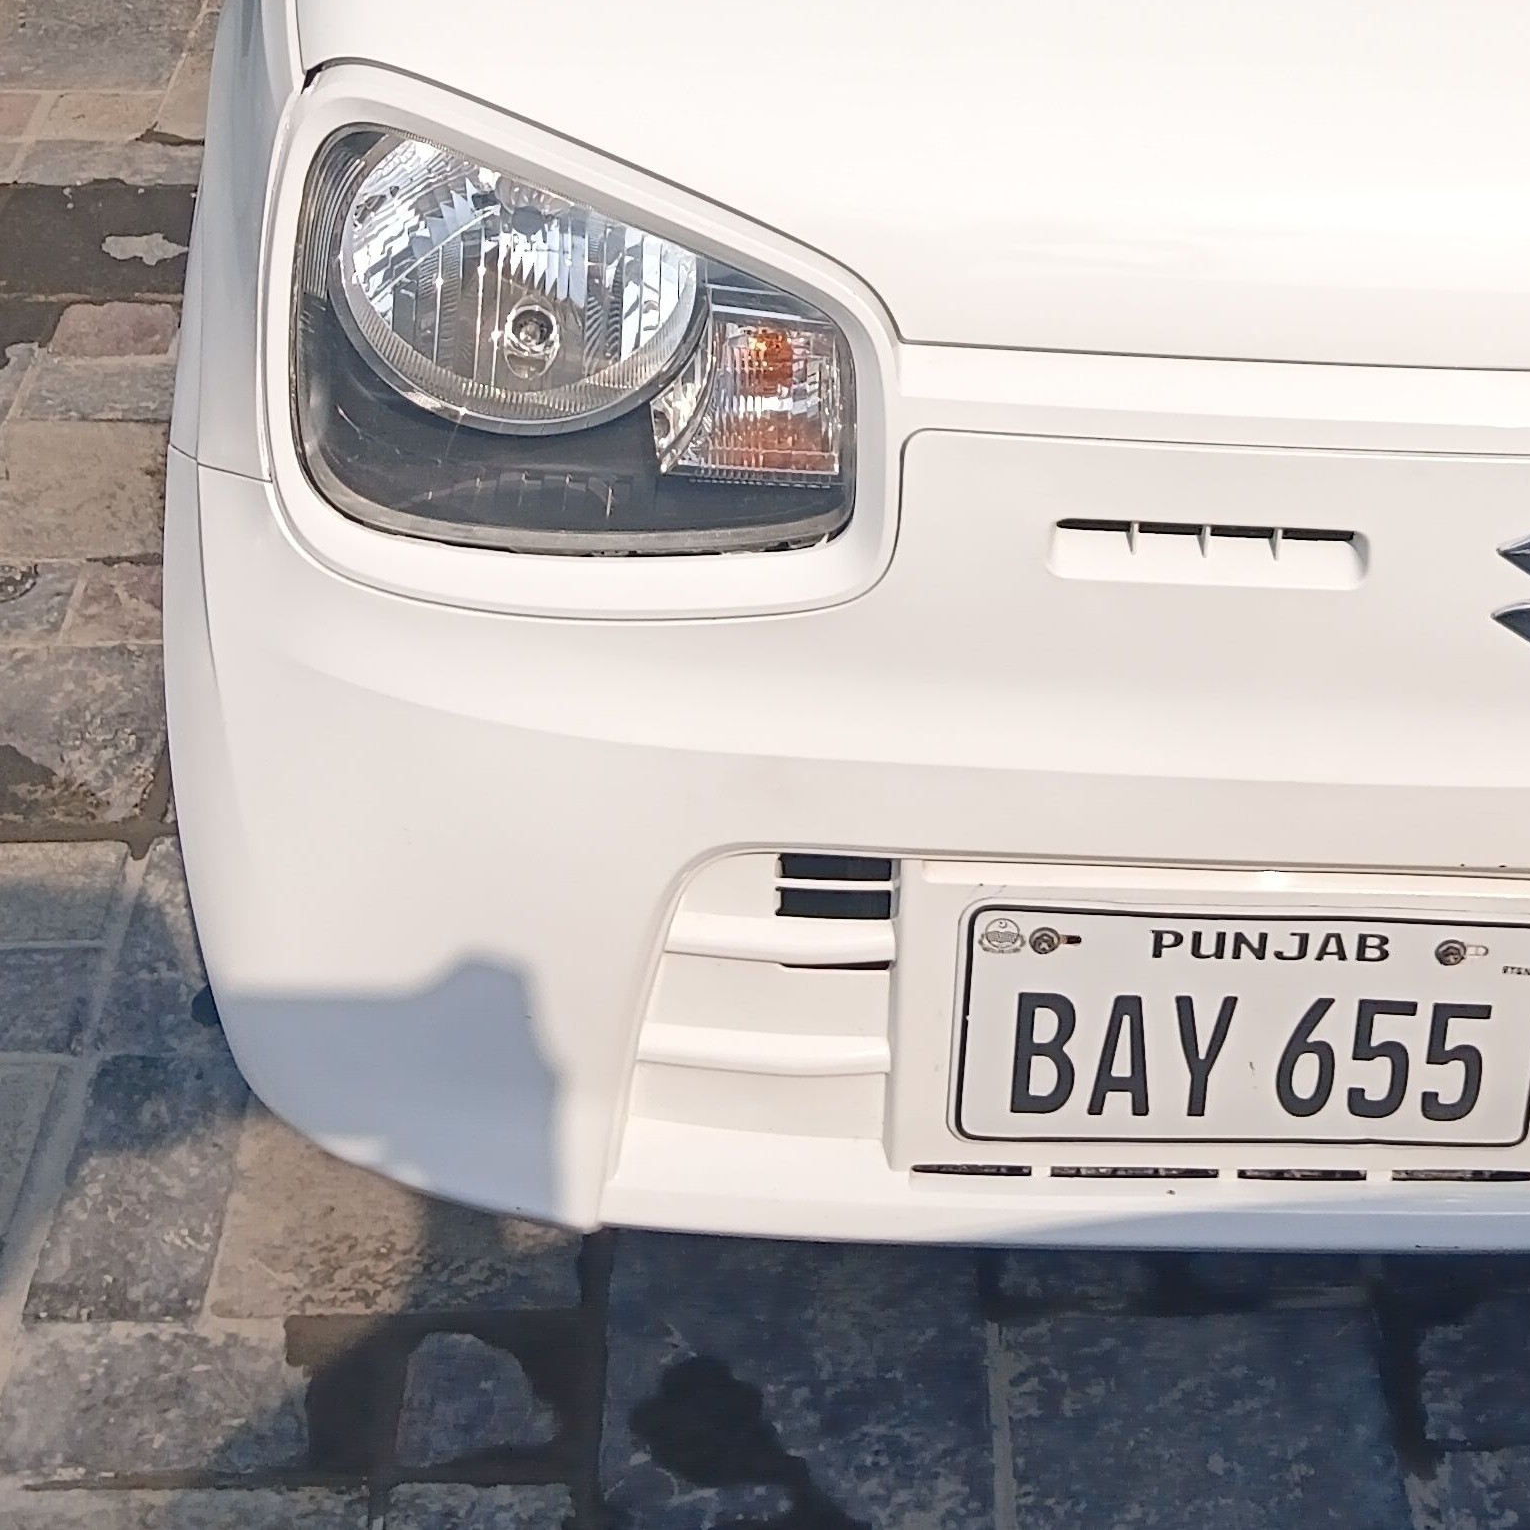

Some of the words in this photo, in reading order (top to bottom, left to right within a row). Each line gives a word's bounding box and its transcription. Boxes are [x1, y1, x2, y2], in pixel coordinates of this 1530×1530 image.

[1151, 929, 1390, 963] PUNJAB
[1010, 992, 1239, 1117] BAY
[1276, 998, 1492, 1122] 655
